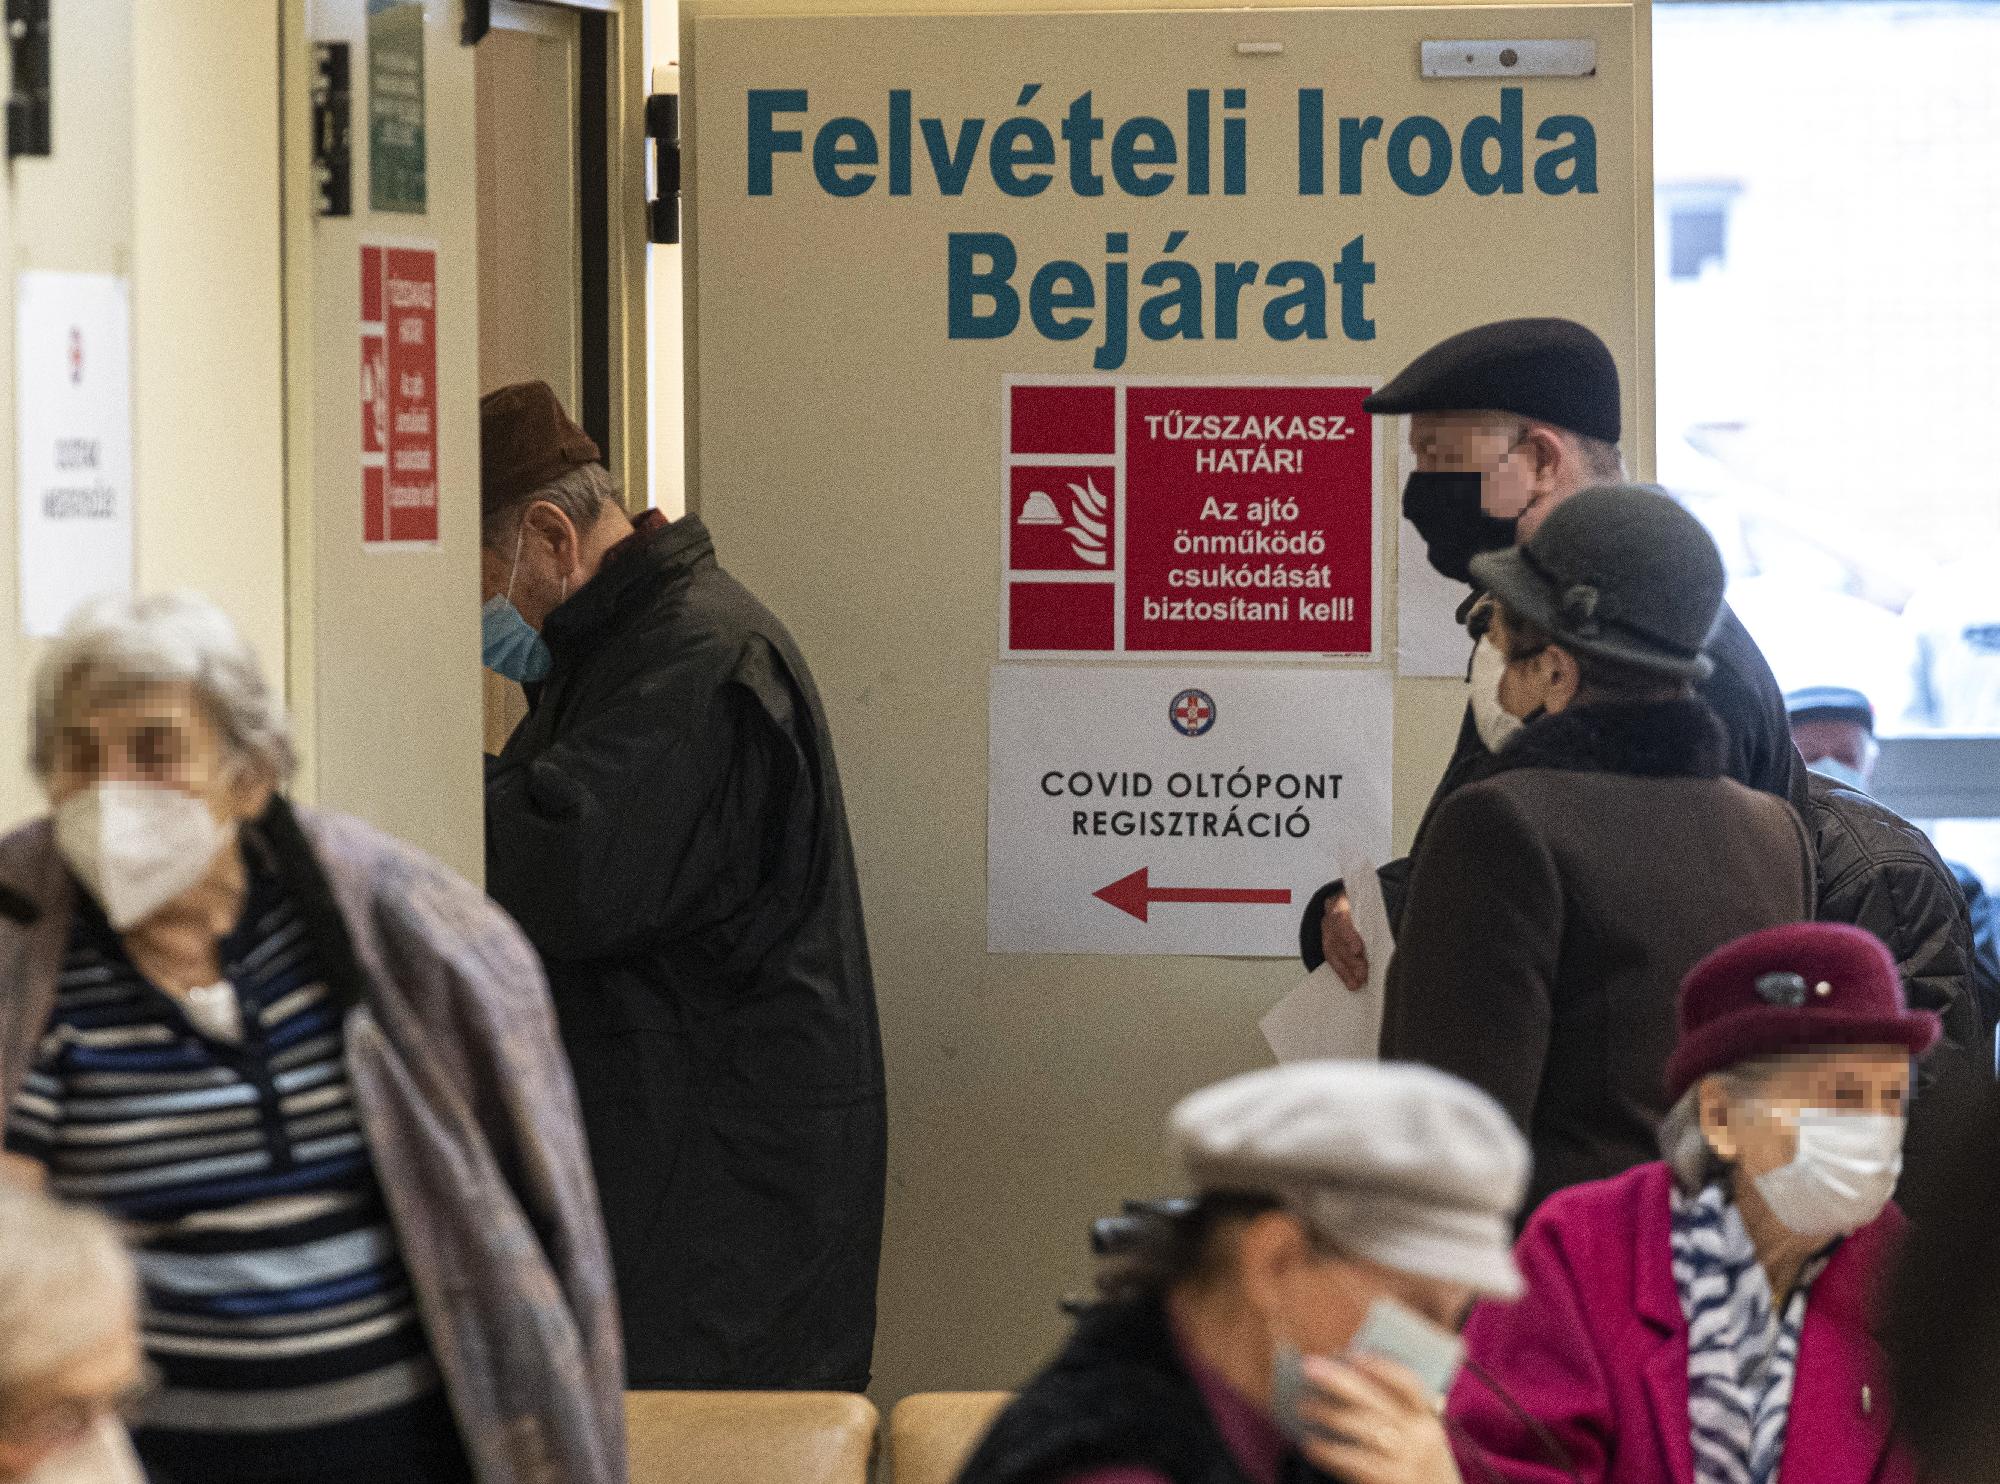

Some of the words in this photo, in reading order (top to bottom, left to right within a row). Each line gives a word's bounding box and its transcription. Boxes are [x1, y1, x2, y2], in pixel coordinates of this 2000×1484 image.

[748, 84, 1246, 197] Felvételi
[1298, 88, 1598, 197] Iroda
[947, 231, 1376, 370] Bejárat
[1144, 410, 1355, 441] TŰZSZAKASZ-
[1196, 444, 1303, 473] HATÁR!
[1200, 496, 1238, 521] Az
[1246, 496, 1300, 527] ajtó
[1173, 530, 1326, 555] önműködő
[1167, 563, 1331, 588] csukódását
[1143, 596, 1289, 621] biztosítani
[1299, 597, 1354, 621] kell!
[1040, 771, 1153, 798] COVID
[1166, 765, 1343, 800] OLTÓPONT
[1072, 805, 1311, 838] REGISZTRÁCIÓ
